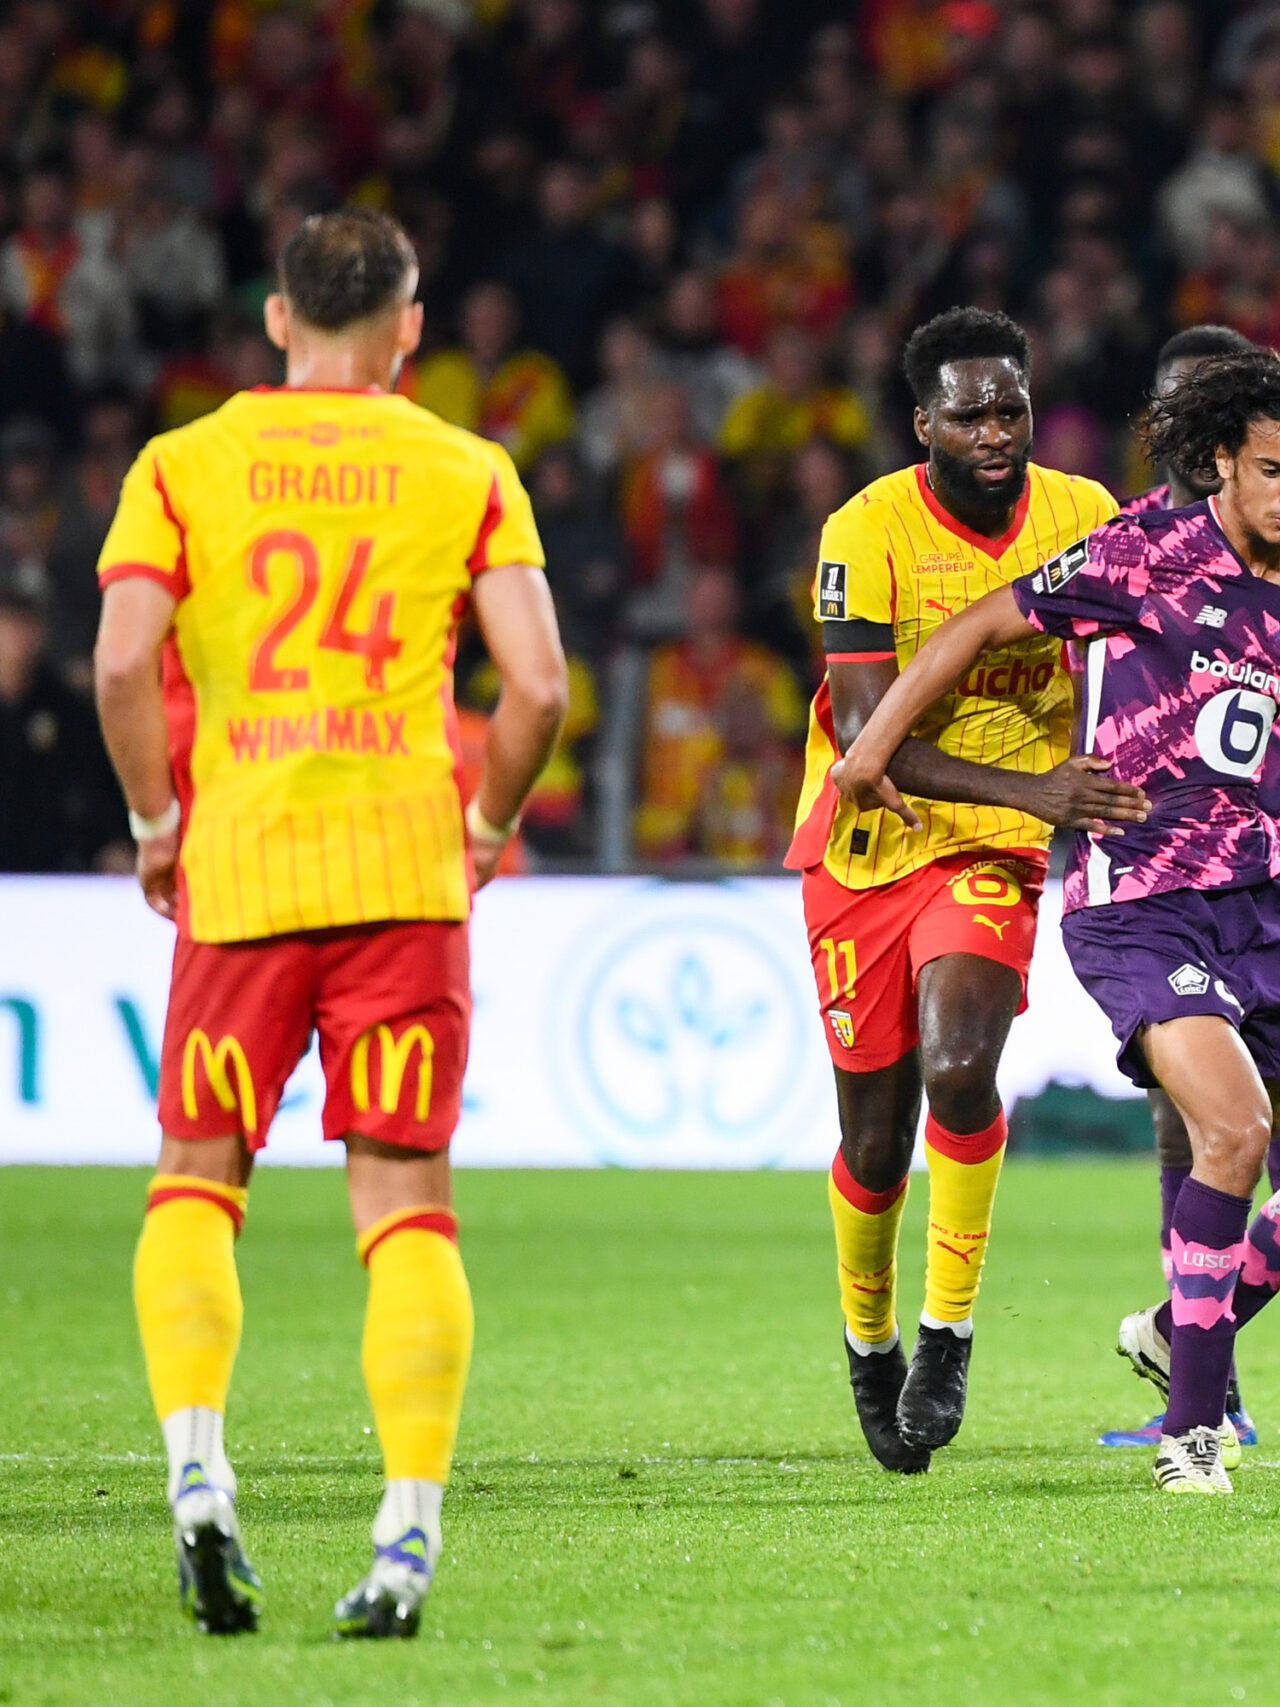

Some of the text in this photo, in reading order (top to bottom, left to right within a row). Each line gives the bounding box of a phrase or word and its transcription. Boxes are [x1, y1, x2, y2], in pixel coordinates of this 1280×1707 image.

[249, 460, 403, 507] GRADIT
[911, 561, 975, 575] LEMPEREUR
[246, 528, 402, 693] 24
[951, 659, 1055, 697] ucha
[227, 705, 412, 764] WINAMAX
[820, 937, 857, 1000] 11
[1183, 1250, 1232, 1269] LOSC
